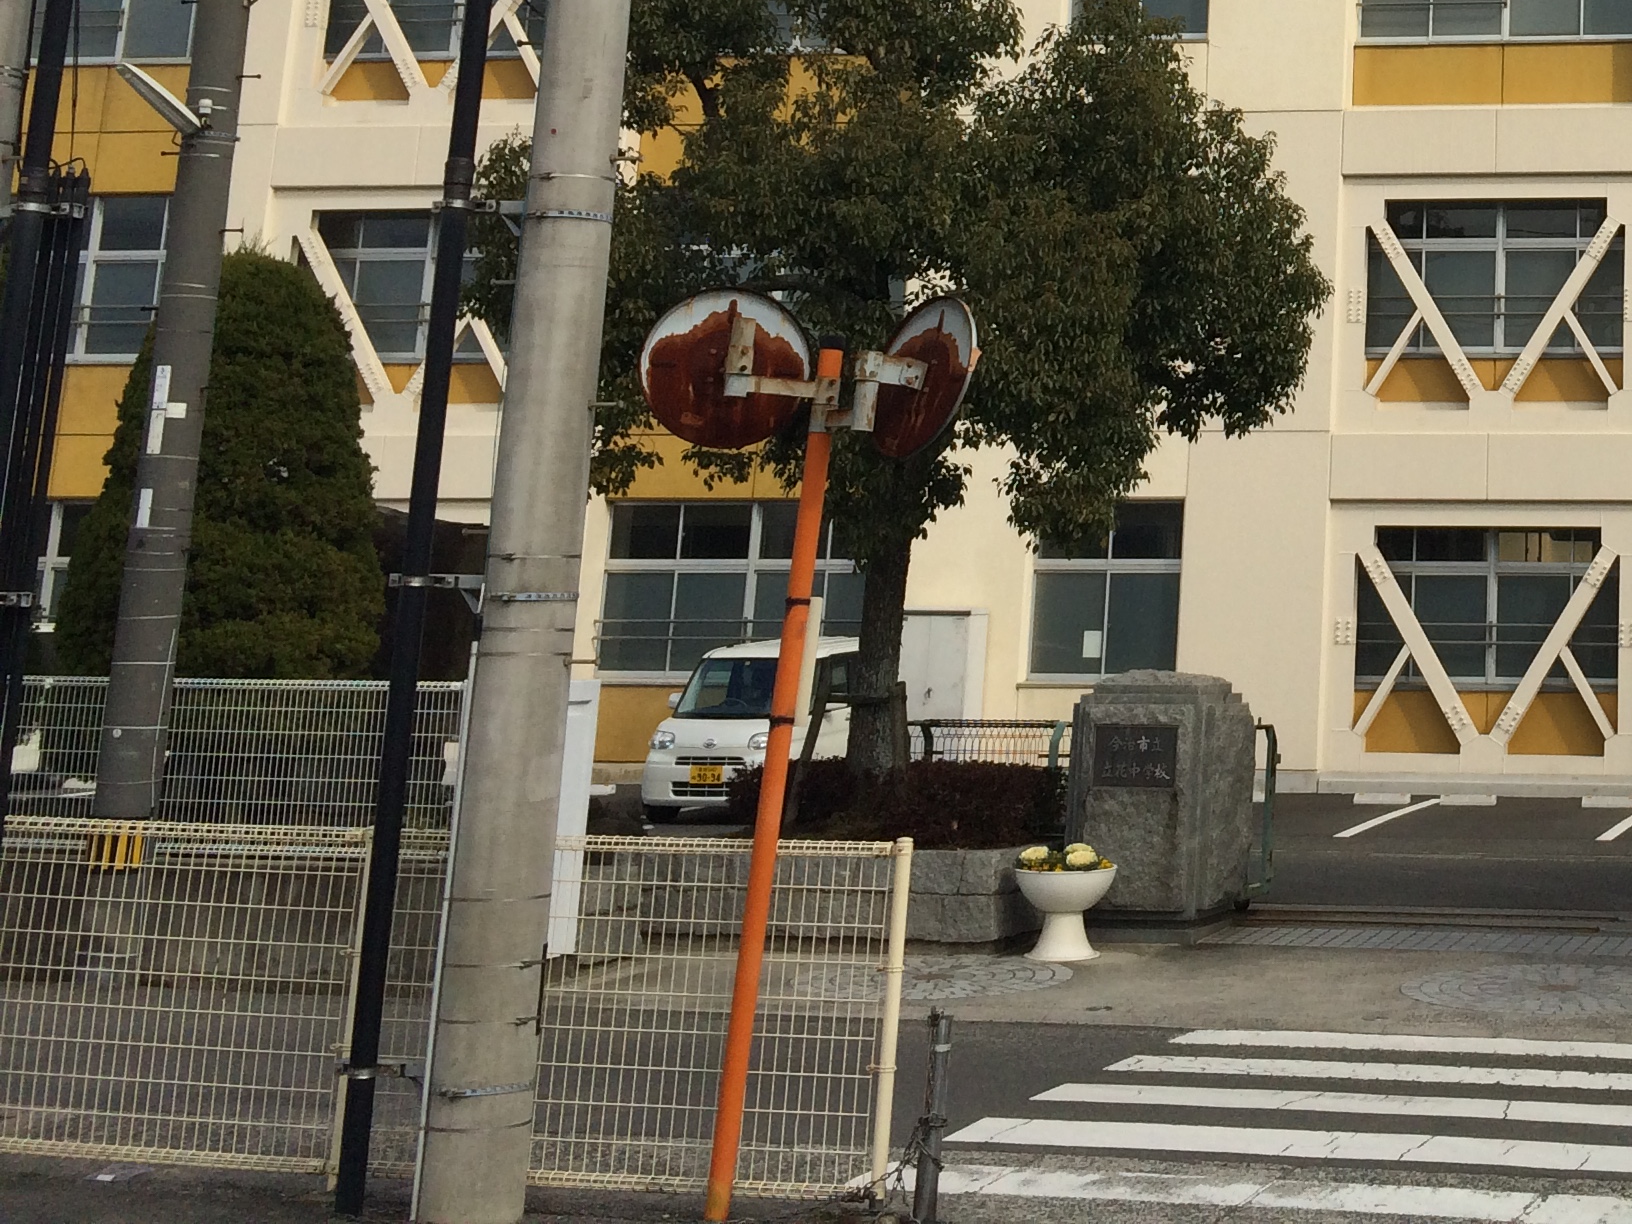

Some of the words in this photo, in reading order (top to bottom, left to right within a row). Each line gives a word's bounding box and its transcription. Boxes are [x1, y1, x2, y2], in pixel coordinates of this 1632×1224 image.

[1108, 735, 1164, 752] 今治市立
[1101, 761, 1171, 780] 立花中学校
